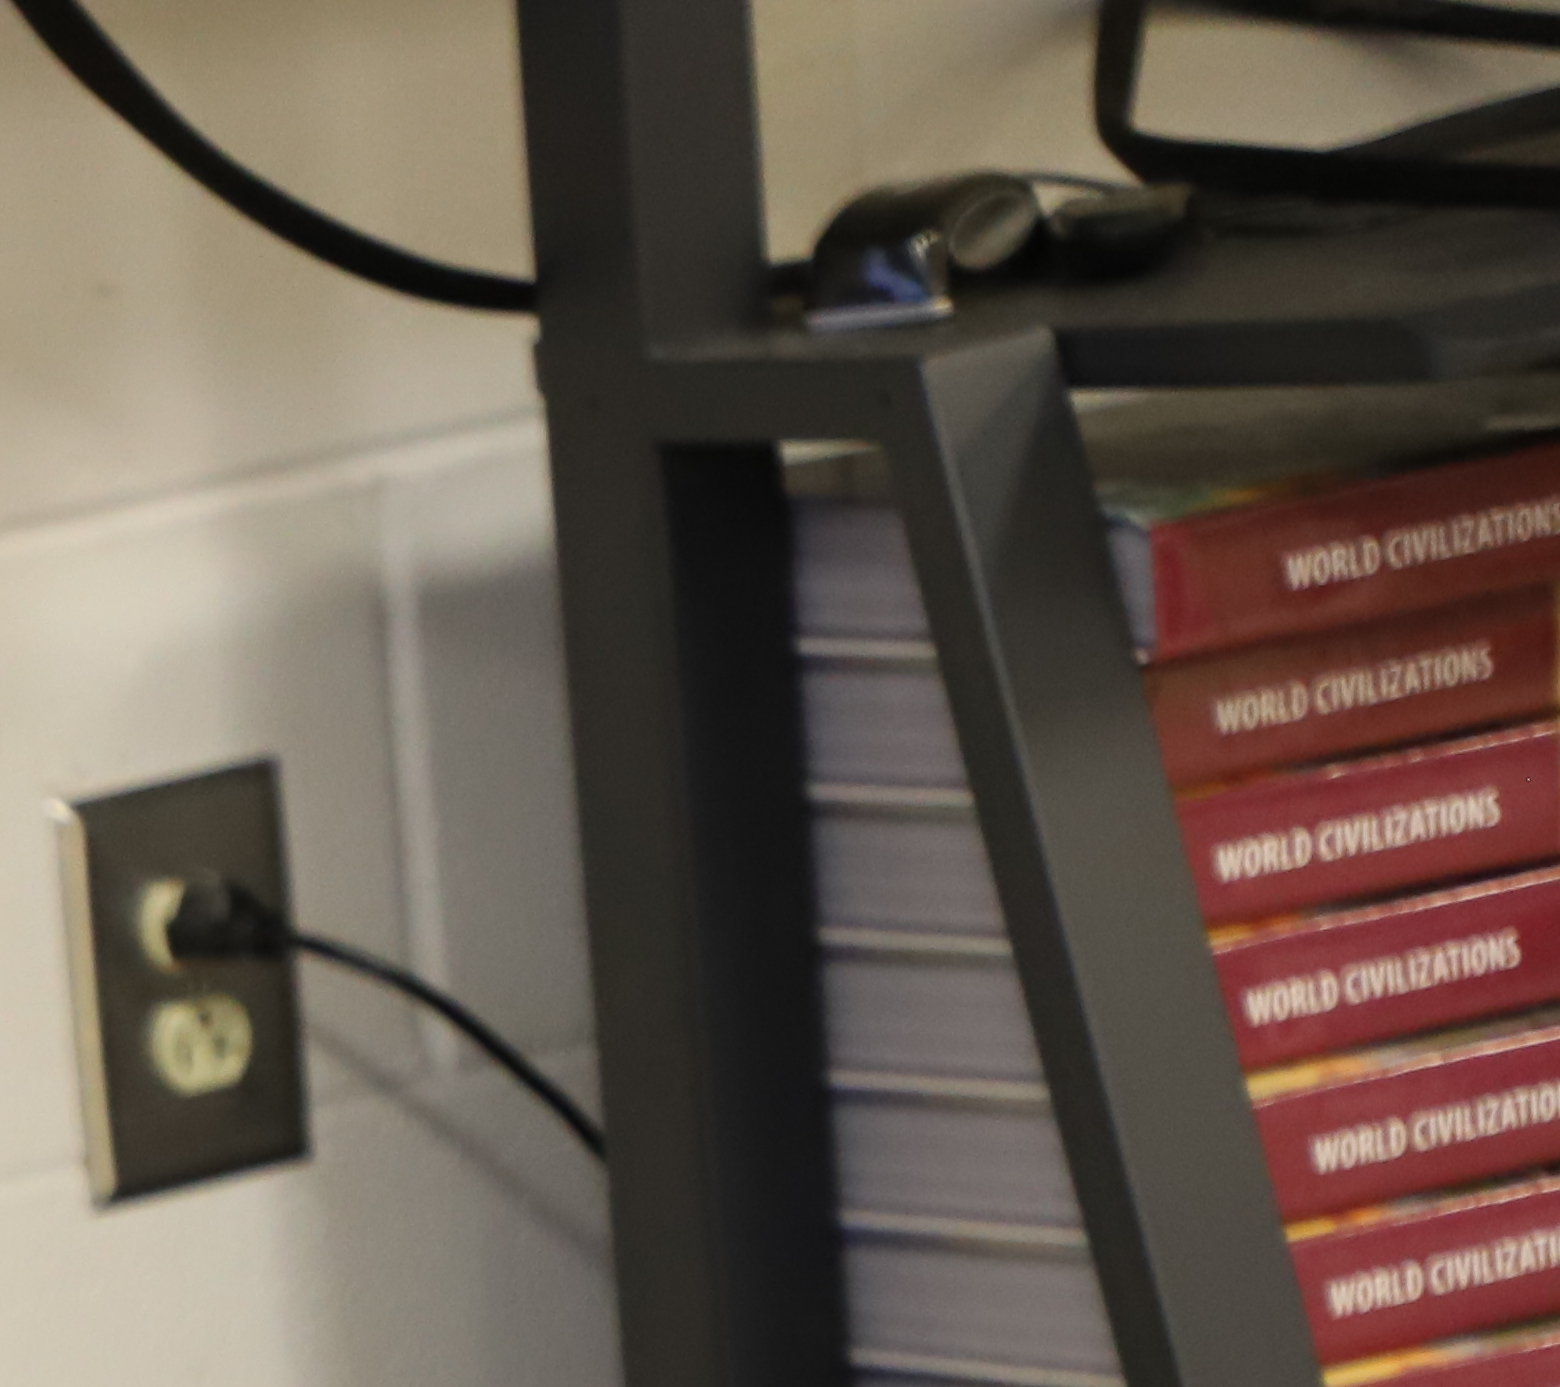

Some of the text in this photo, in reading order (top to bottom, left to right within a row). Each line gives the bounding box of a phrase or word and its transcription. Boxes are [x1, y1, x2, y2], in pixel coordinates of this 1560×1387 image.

[1287, 538, 1381, 591] WORLD
[1216, 644, 1493, 735] WORLD CIVILIZATIONS
[1216, 789, 1501, 883] WORLD CIVILIZATIONS
[1245, 930, 1522, 1028] WORLD CIVILIZATIONS
[1312, 1080, 1560, 1175] WORLD CIVILIZATIO
[1327, 1229, 1560, 1320] WORLD CIVILIZATI
